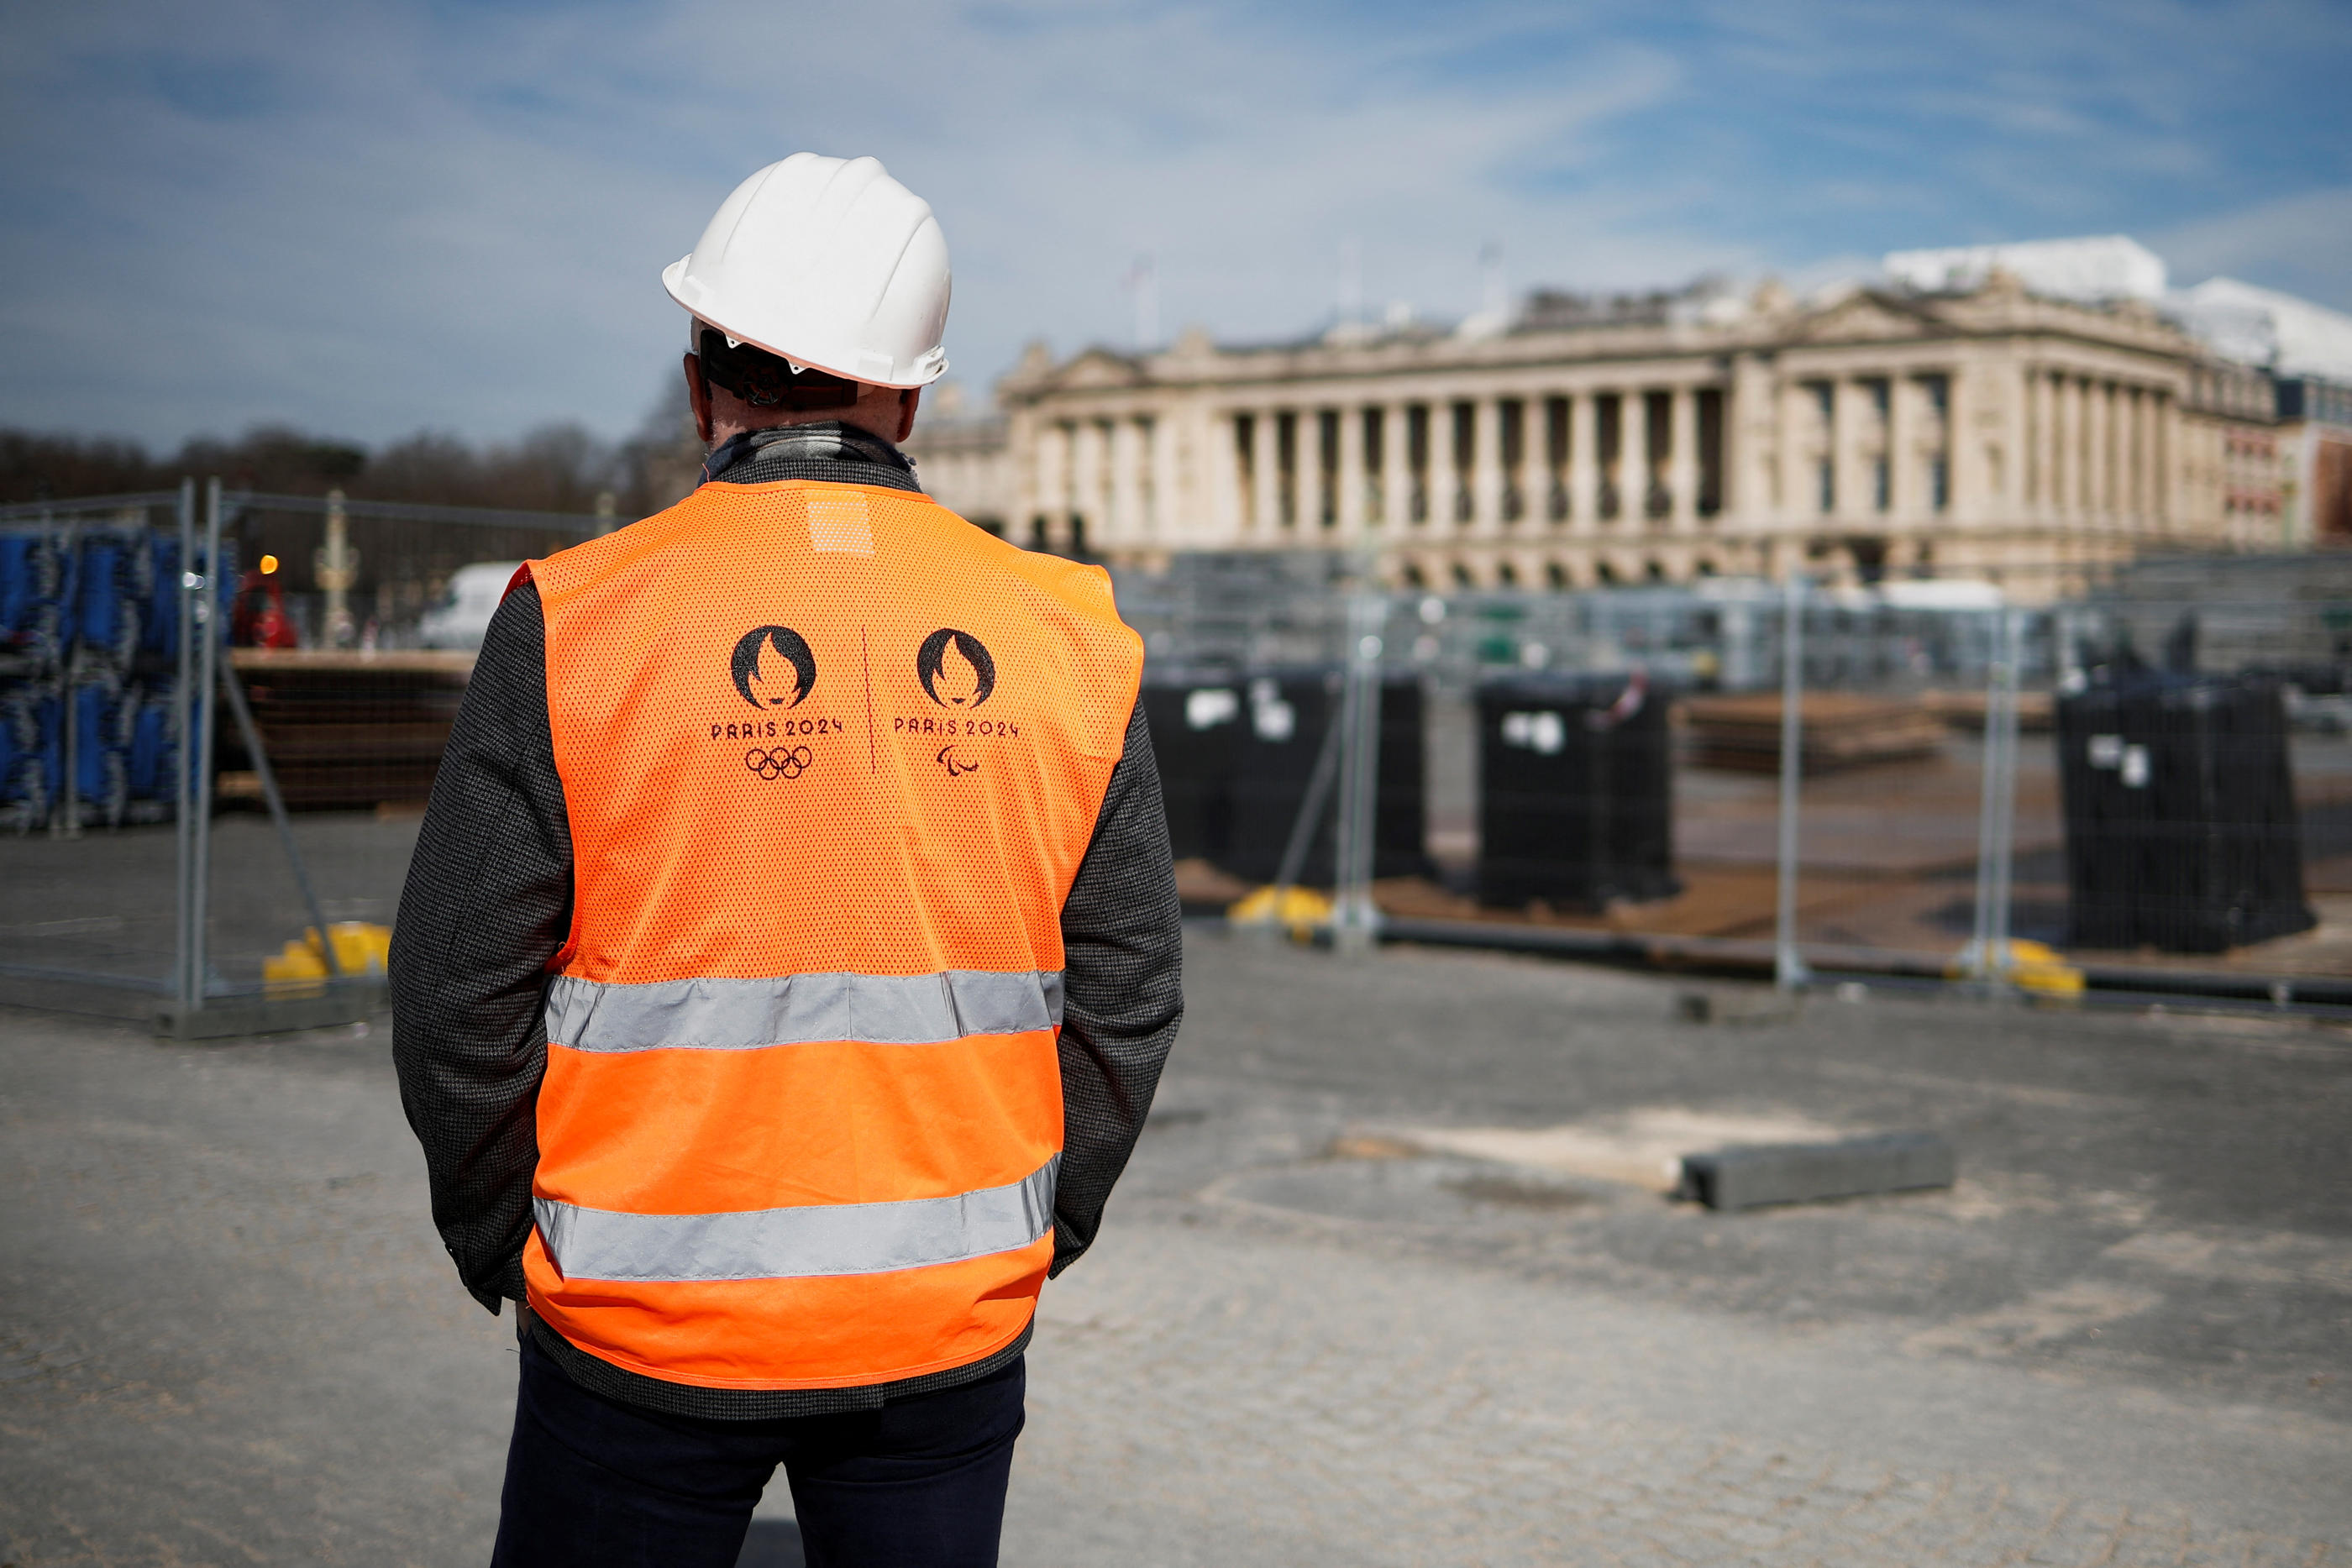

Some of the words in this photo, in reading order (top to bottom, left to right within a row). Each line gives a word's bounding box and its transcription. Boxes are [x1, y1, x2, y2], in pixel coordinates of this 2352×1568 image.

[711, 721, 777, 740] PARIS
[785, 718, 843, 737] 2024
[895, 717, 957, 735] PARIS
[966, 721, 1019, 738] 2024
